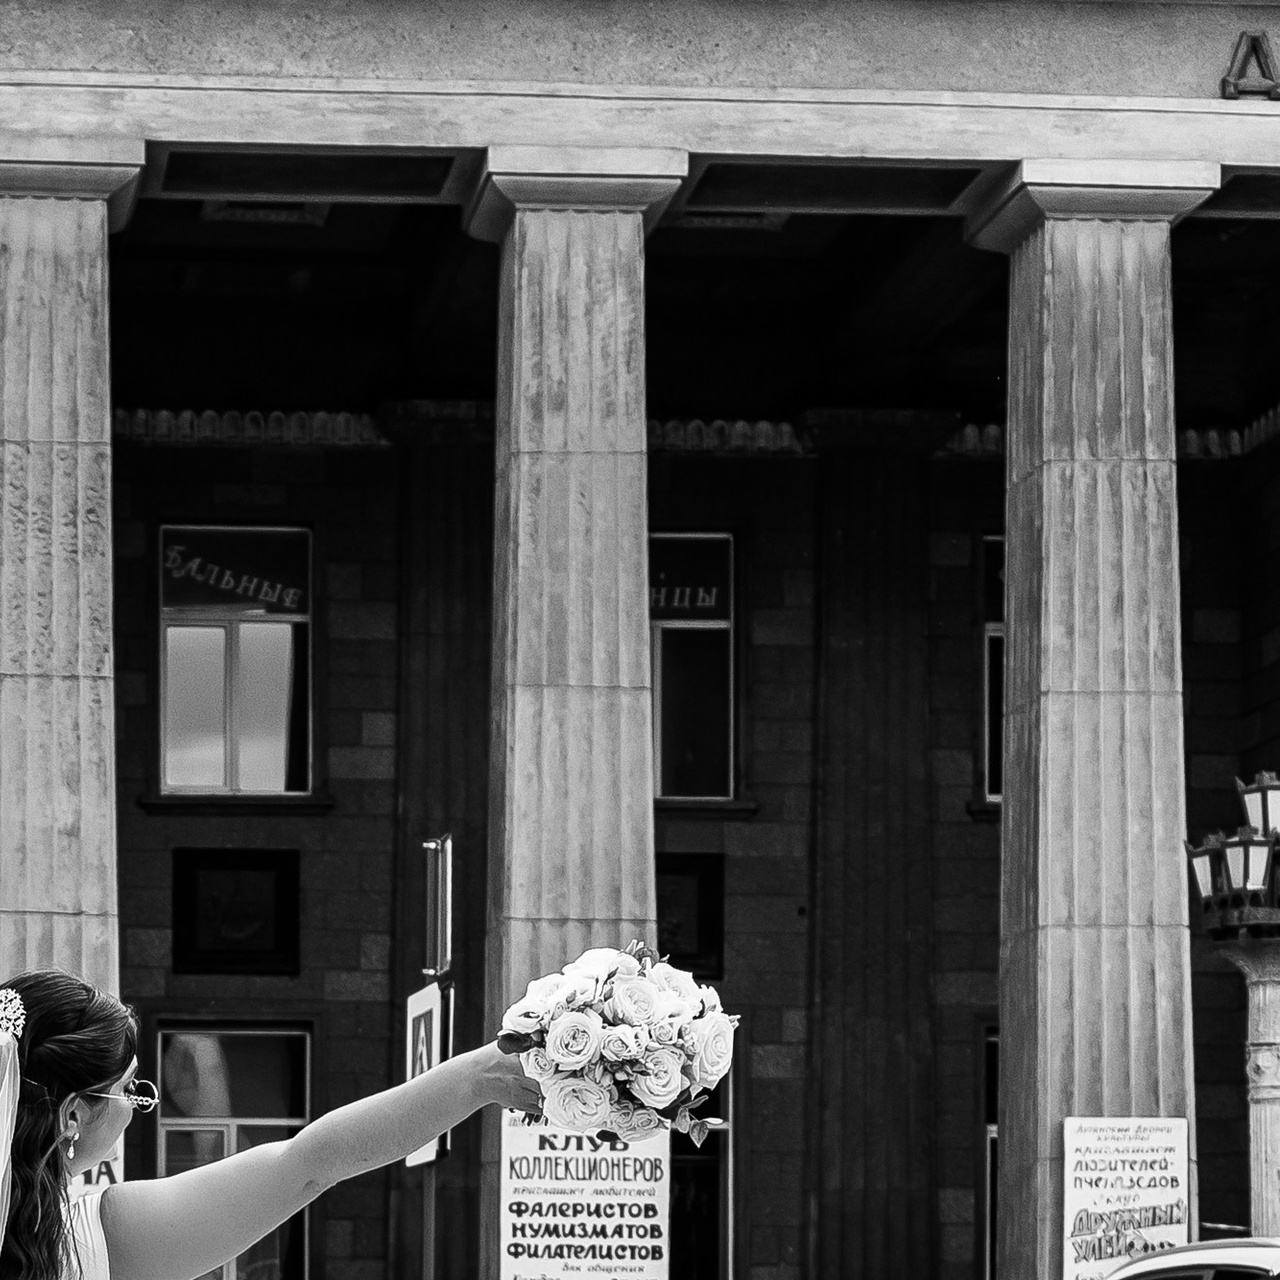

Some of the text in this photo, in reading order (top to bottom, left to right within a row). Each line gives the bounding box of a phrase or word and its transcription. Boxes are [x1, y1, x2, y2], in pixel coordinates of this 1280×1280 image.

[165, 544, 302, 608] БАЛЬНЫЕ
[649, 586, 718, 609] НЦЫ
[509, 1156, 664, 1183] КОЛЛЕКЦИОНЕРОВ
[508, 1201, 659, 1219] ФАЛЕРИСТОВ
[1071, 1198, 1187, 1238] ДРУЖНЫЙ
[511, 1222, 663, 1240] НУМИЗМАТОВ
[506, 1242, 664, 1261] ФИЛАТЕЛИСТОВ
[1072, 1232, 1129, 1263] УЛЕЙ
